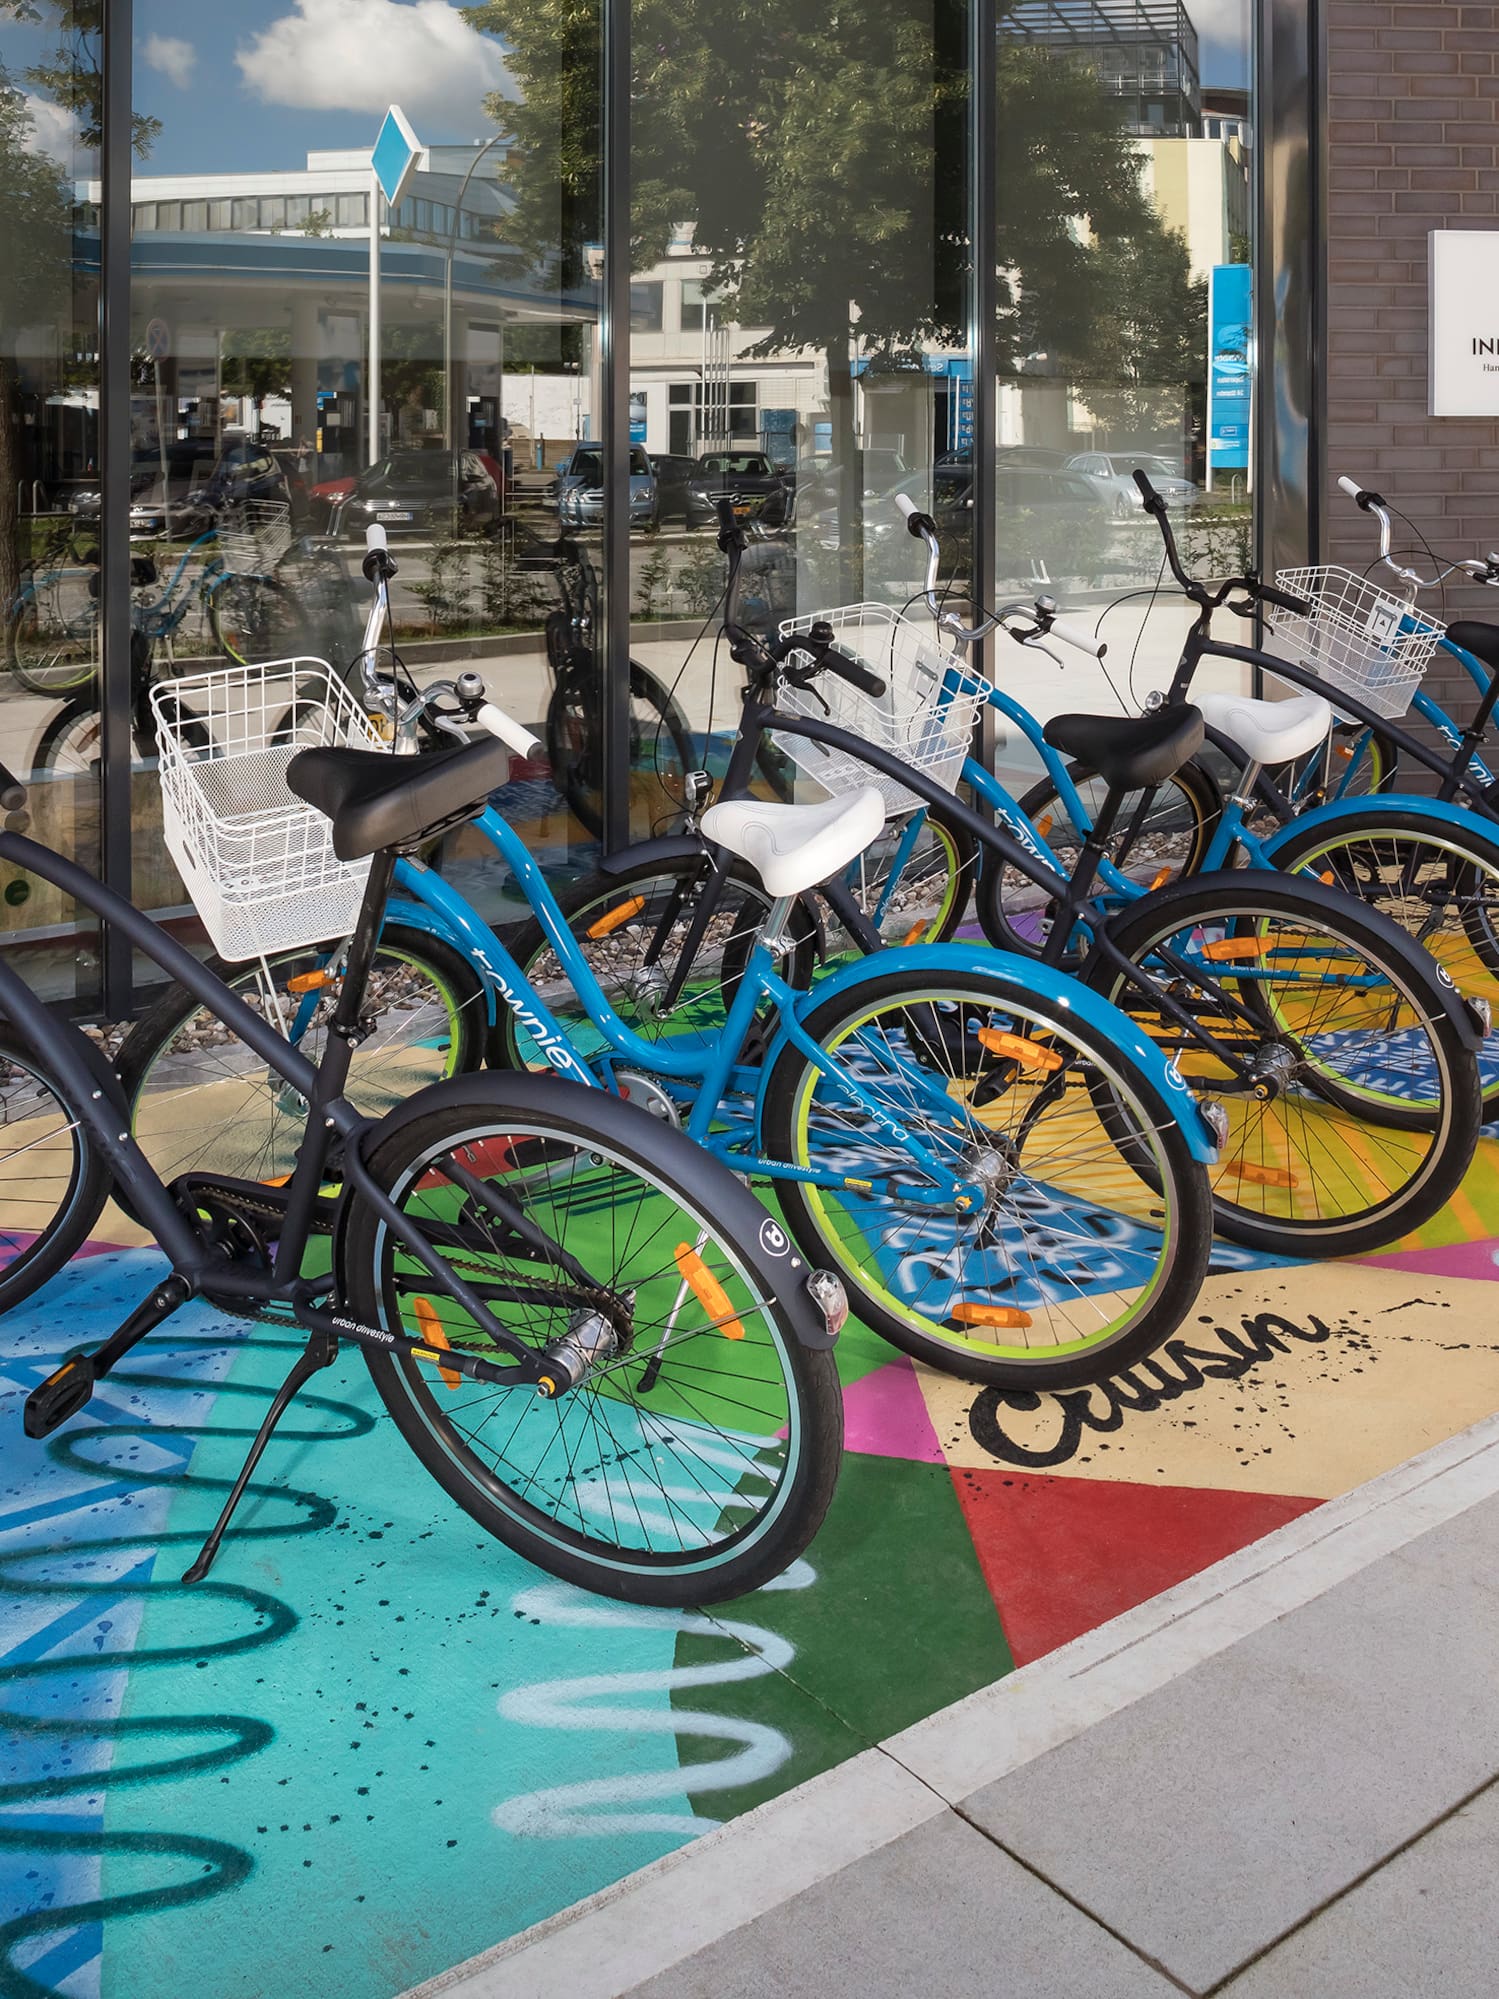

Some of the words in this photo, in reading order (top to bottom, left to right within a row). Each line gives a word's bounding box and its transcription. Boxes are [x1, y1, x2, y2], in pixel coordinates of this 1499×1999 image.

[1472, 337, 1499, 355] IN
[471, 947, 591, 1087] townie
[837, 1084, 909, 1141] electra
[758, 1159, 781, 1168] urban
[332, 1316, 355, 1330] urban
[356, 1324, 395, 1343] drivestyle
[968, 1312, 1330, 1468] Cruisin
